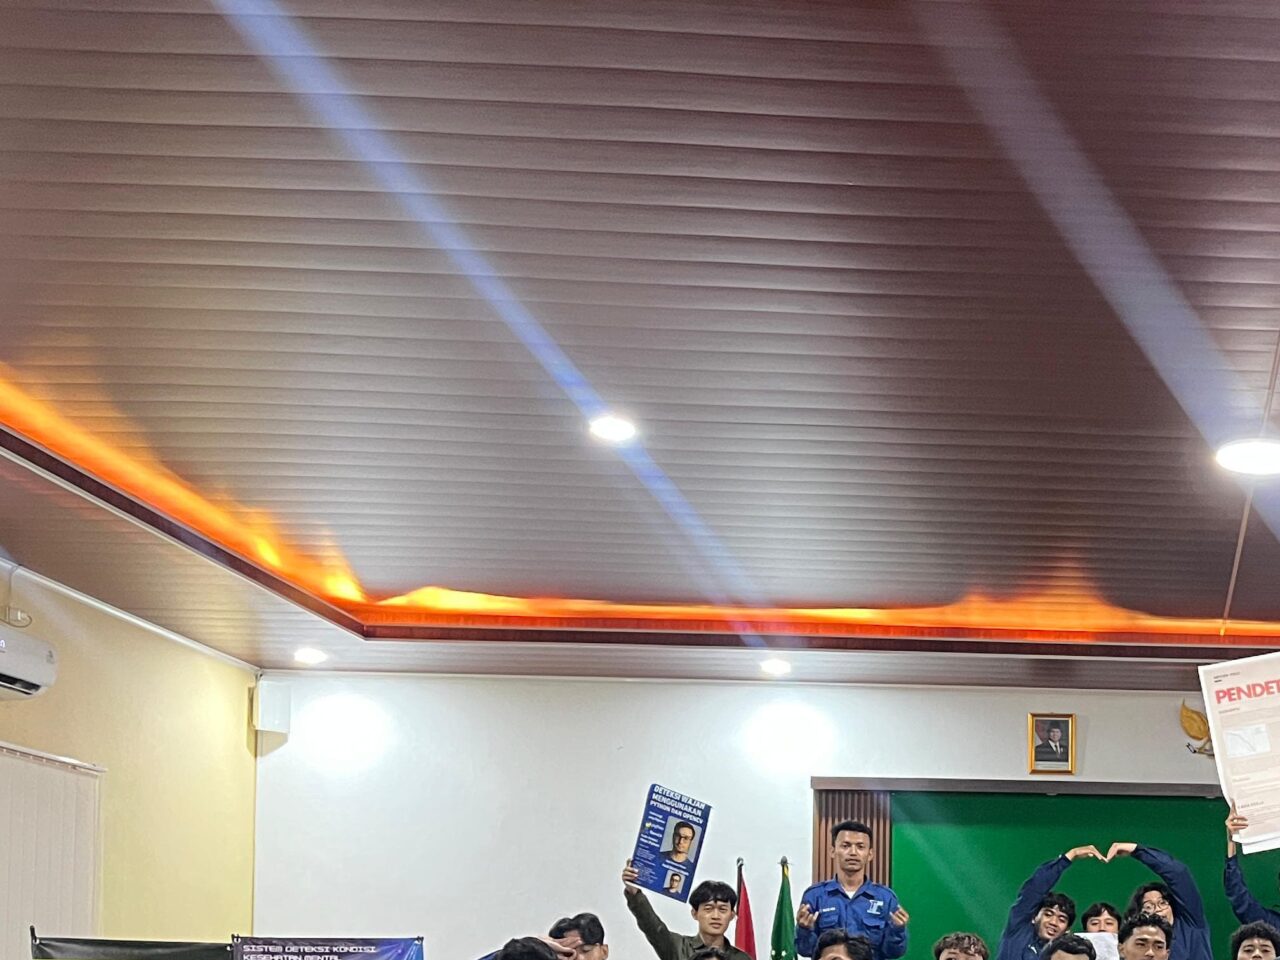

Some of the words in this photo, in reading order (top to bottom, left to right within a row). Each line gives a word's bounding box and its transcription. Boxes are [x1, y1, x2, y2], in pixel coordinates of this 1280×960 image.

[654, 785, 681, 800] DETEKSI
[652, 793, 702, 816] MENGGUNAKAN
[332, 945, 376, 953] KONDISI
